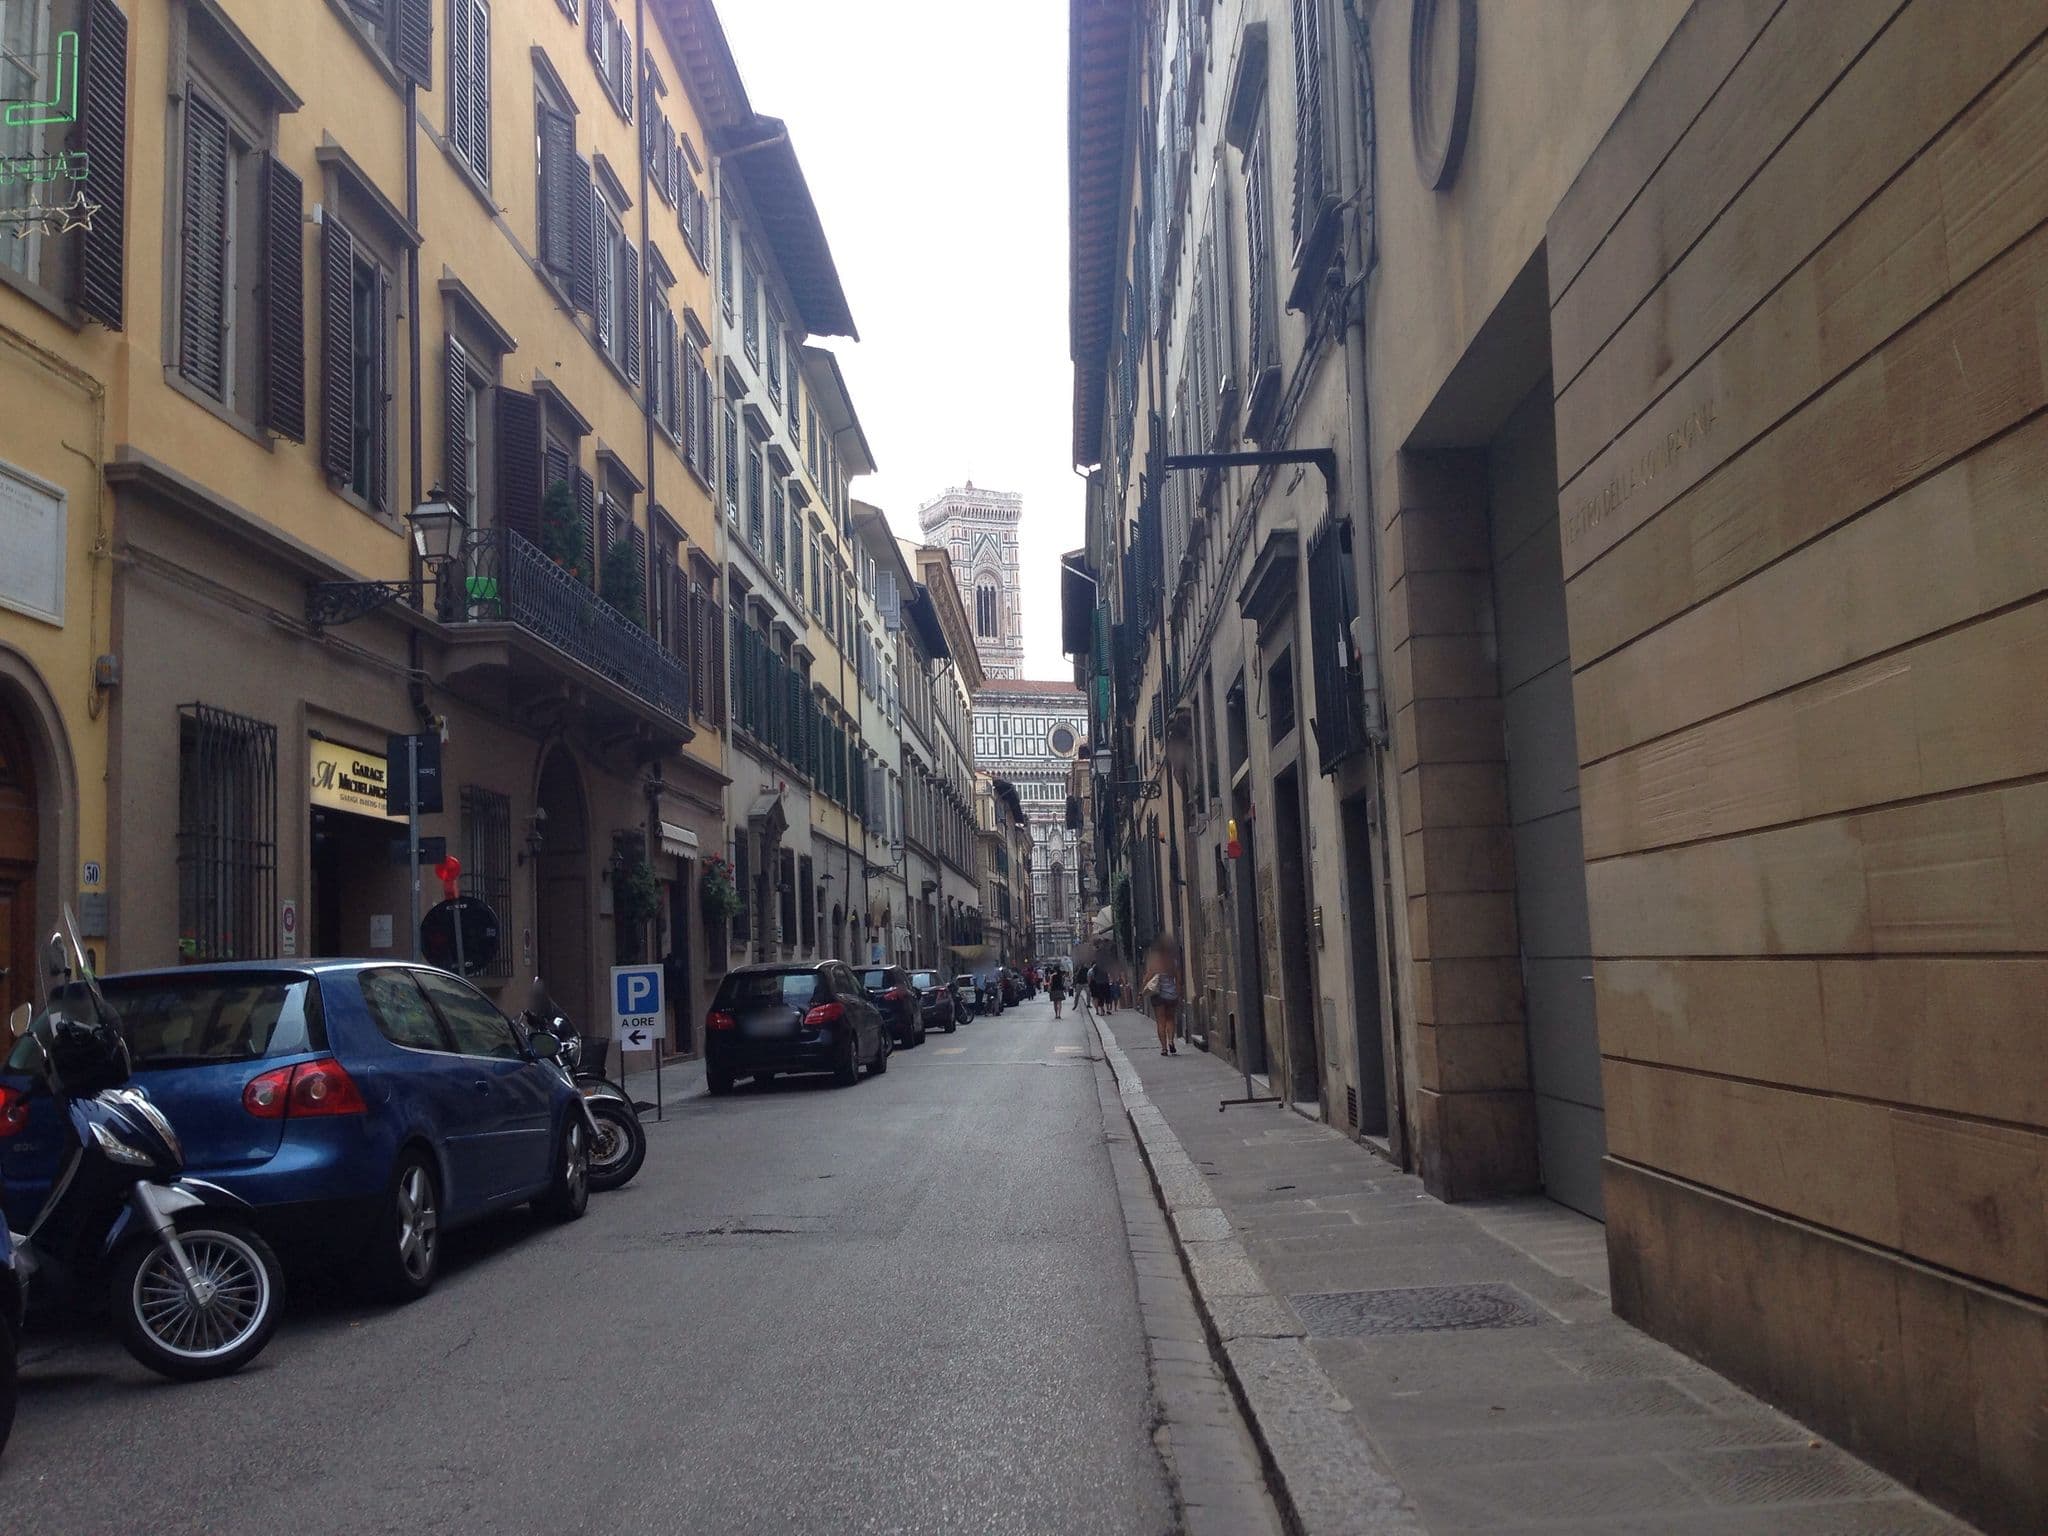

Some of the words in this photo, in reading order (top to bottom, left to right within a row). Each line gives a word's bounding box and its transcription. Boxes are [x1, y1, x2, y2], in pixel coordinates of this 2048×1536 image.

[628, 976, 651, 1012] P
[621, 1018, 630, 1028] A
[632, 1017, 655, 1027] ORE
